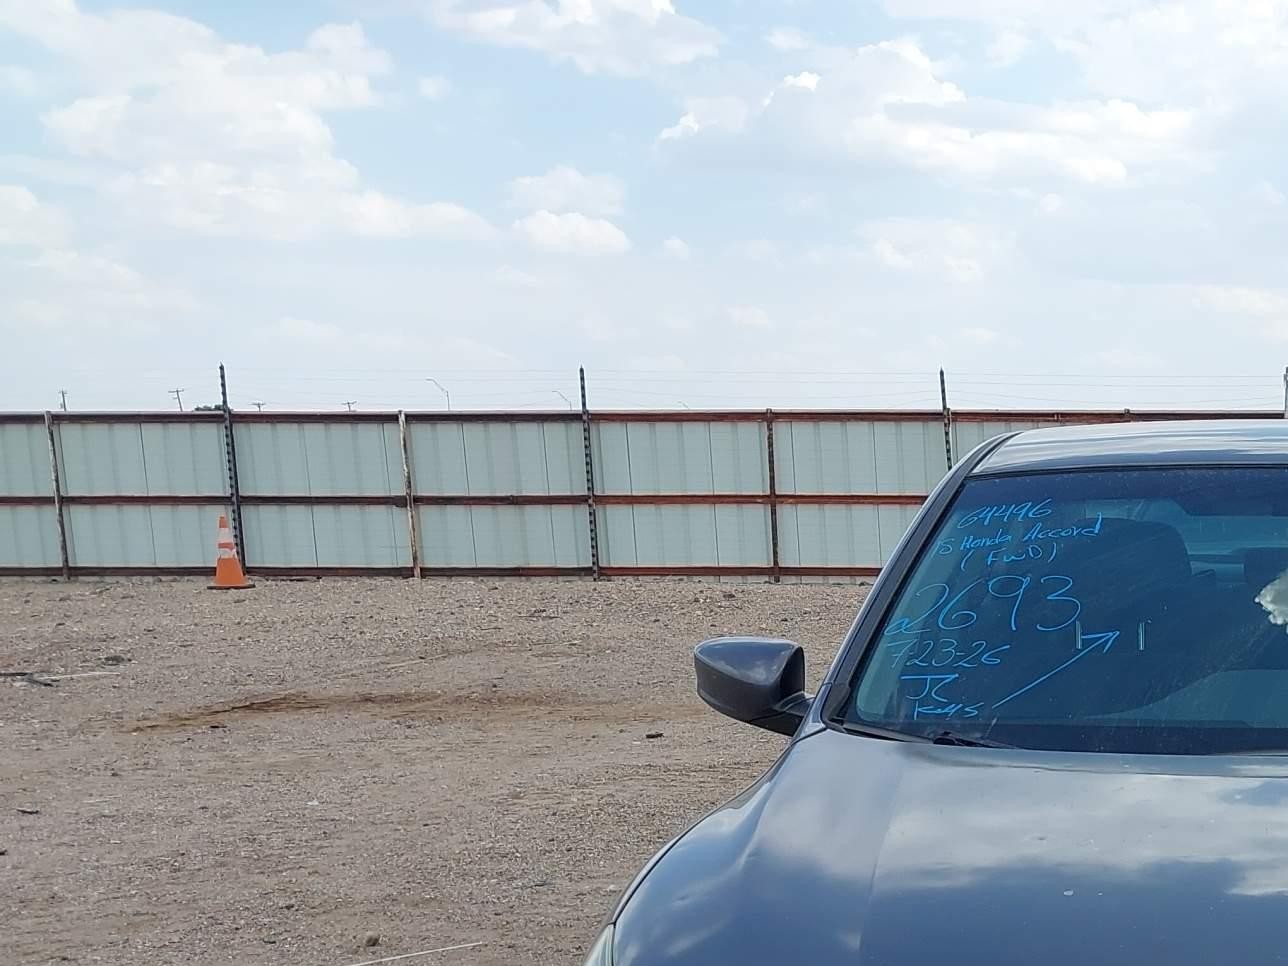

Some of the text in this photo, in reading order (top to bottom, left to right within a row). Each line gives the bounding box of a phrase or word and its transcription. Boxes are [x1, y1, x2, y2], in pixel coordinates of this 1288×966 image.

[957, 498, 1054, 529] 64496
[960, 528, 1012, 551] Honda
[1022, 511, 1104, 541] Accord
[883, 575, 1082, 636] 2693
